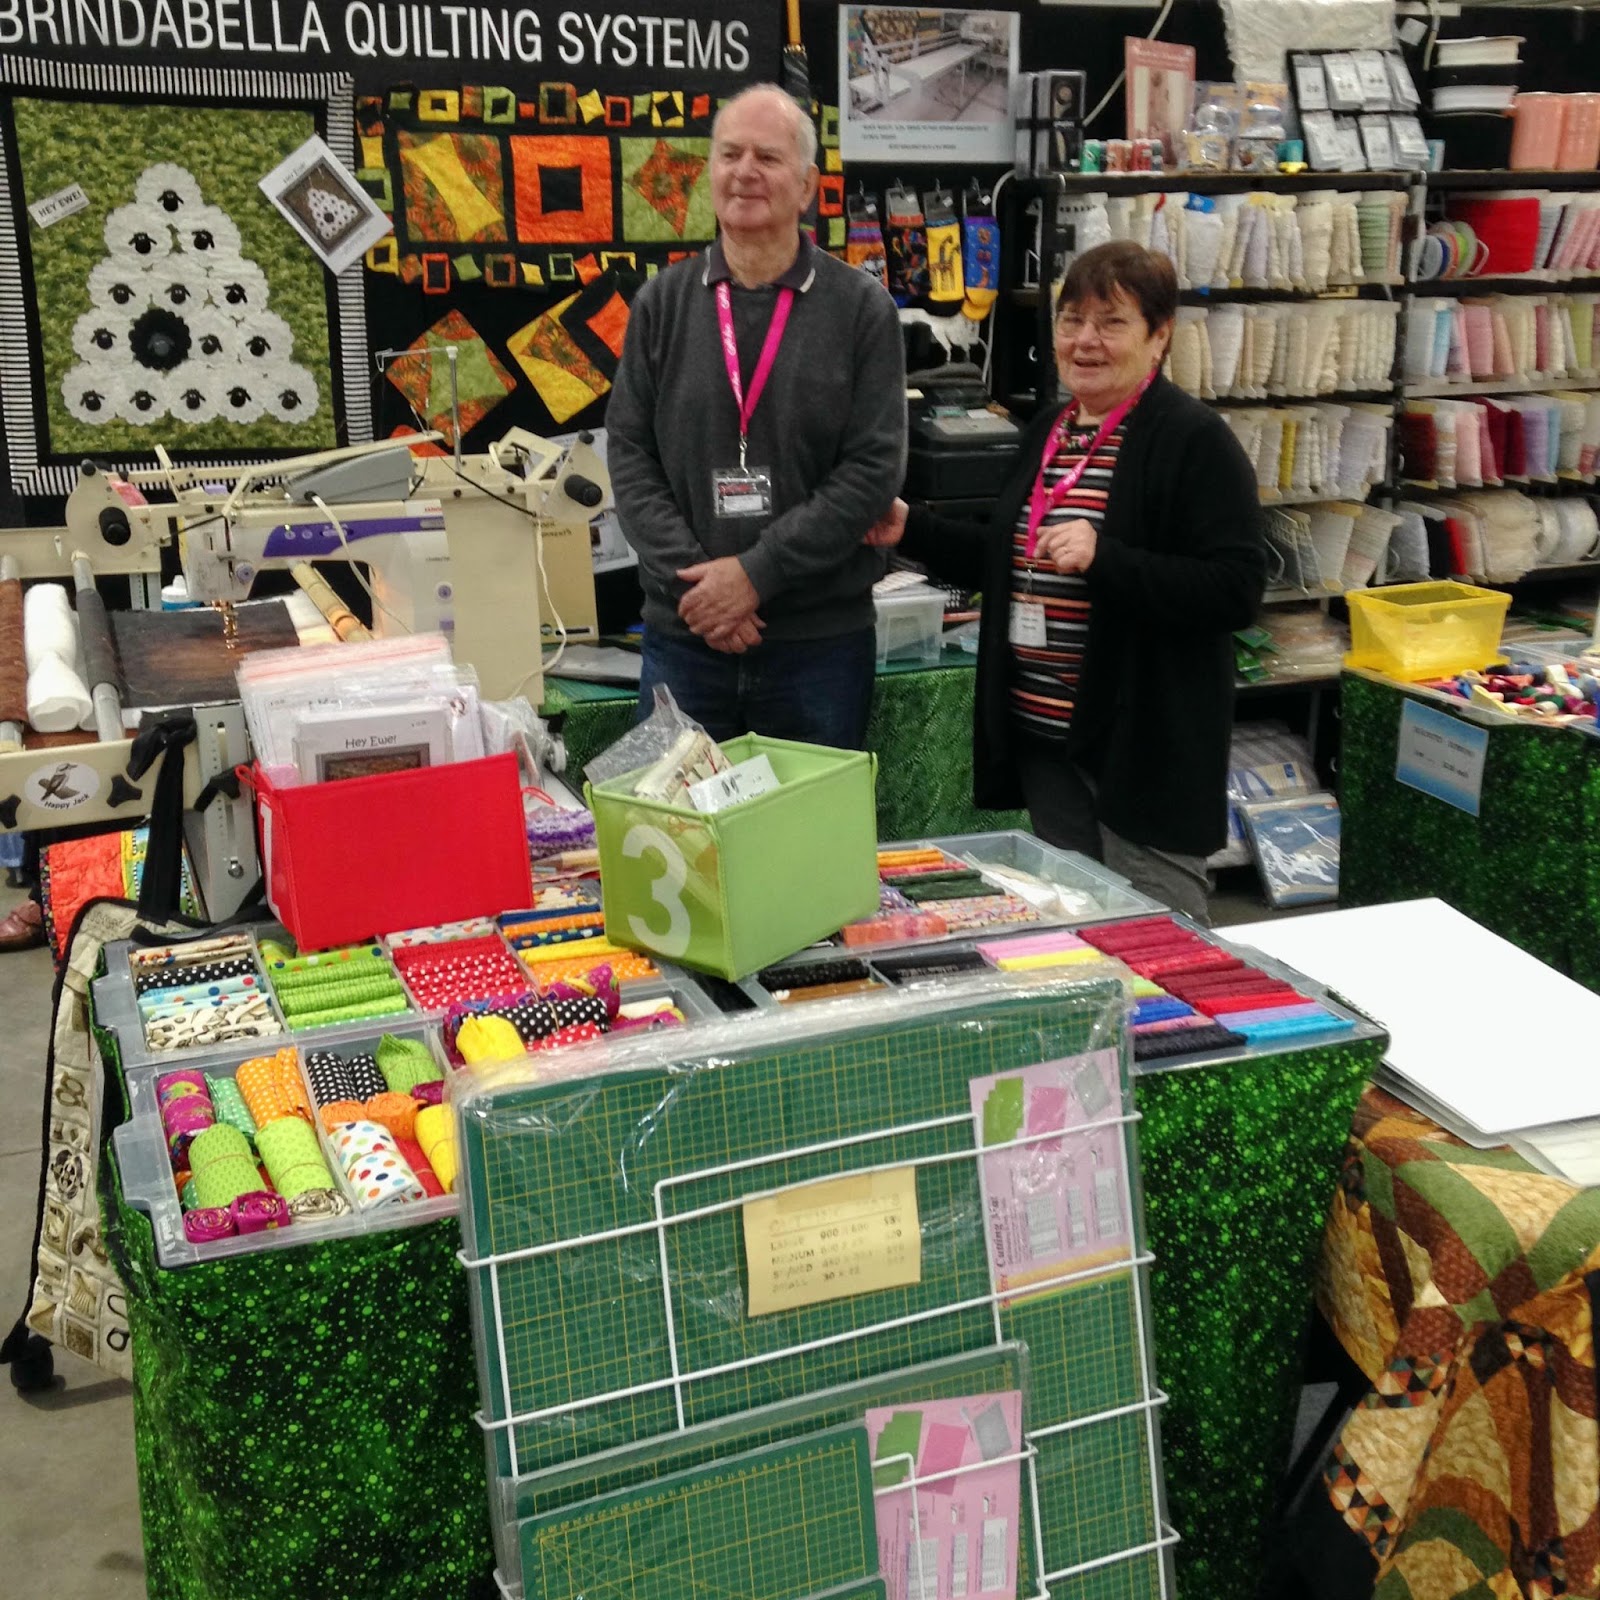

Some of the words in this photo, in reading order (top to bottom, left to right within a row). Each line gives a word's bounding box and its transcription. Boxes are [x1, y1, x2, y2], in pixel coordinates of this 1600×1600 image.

[0, 0, 331, 54] BRINDABELLA
[345, 0, 542, 63] QUILTING
[557, 11, 750, 73] SYSTEMS
[38, 202, 57, 217] HEY
[59, 190, 82, 207] EWE!
[344, 738, 367, 750] Hey
[44, 800, 71, 810] Happy
[73, 794, 91, 807] Jack
[621, 824, 692, 957] 3
[993, 1222, 1006, 1268] Cutting
